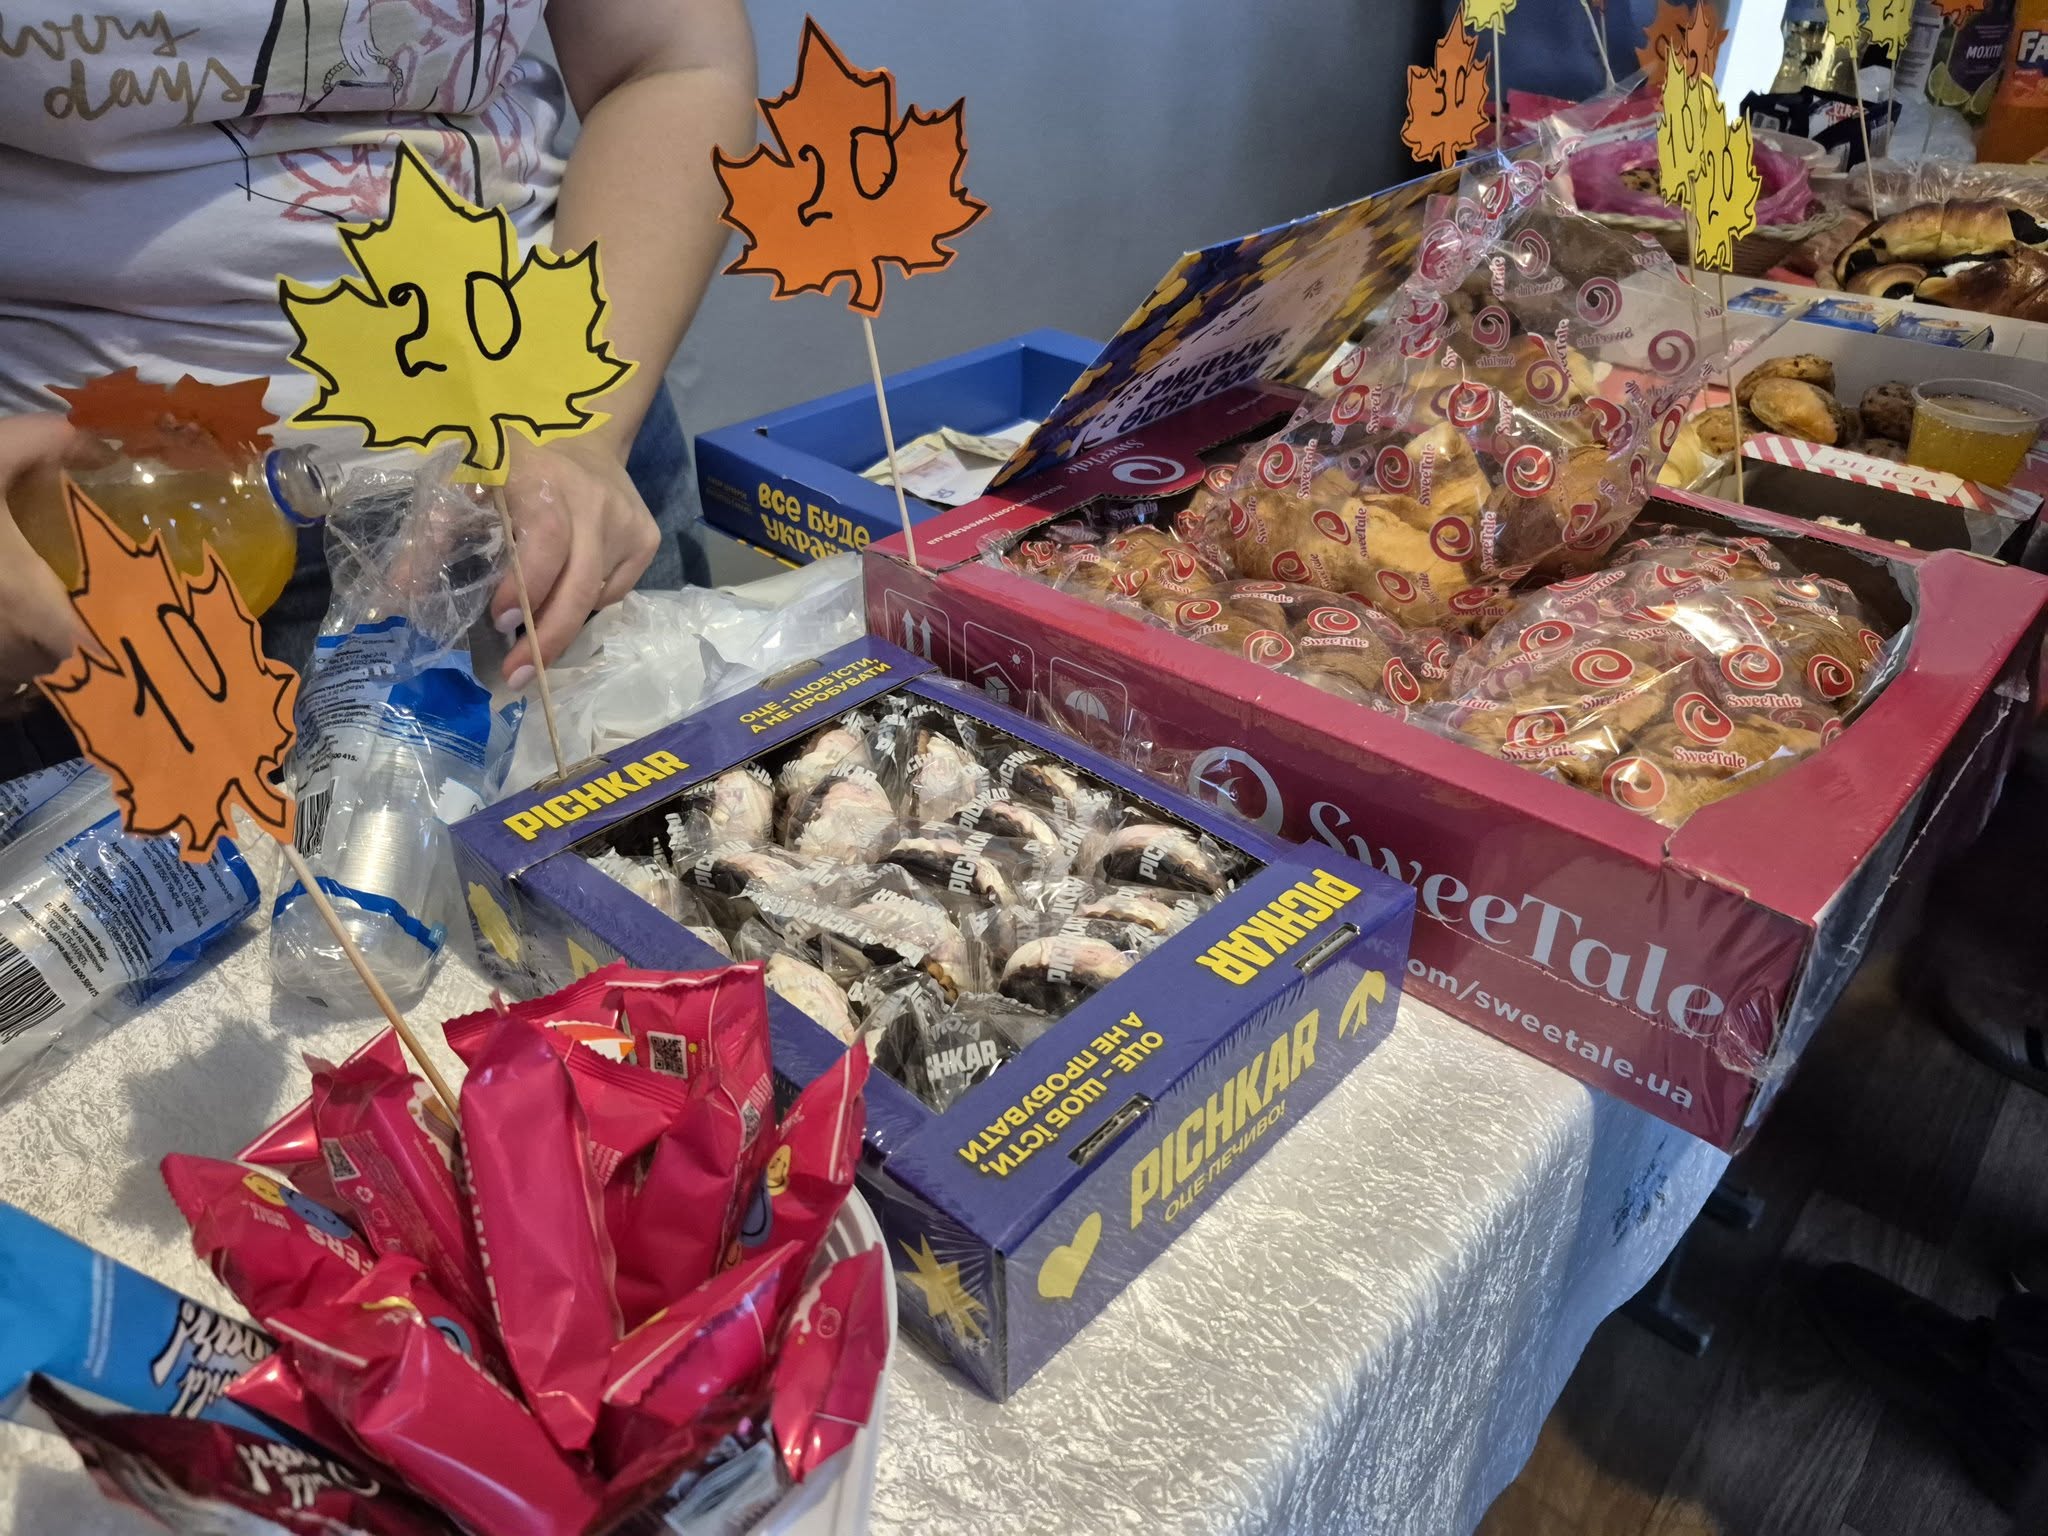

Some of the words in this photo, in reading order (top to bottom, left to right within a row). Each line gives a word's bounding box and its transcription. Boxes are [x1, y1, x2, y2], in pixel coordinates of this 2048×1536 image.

[44, 57, 262, 127] days
[1431, 65, 1466, 116] 30
[1666, 104, 1695, 169] 10
[797, 126, 897, 227] 20
[1708, 147, 1735, 225] 20
[388, 271, 521, 377] 20
[1067, 439, 1144, 475] SweeTale
[1297, 438, 1318, 499] SweeTale
[1418, 443, 1436, 506] SweeTale
[1480, 510, 1497, 573] SweeTale
[1561, 570, 1626, 608] SweeTale
[1301, 636, 1370, 649] SweeTale
[120, 603, 227, 753] 10
[751, 722, 765, 734] А
[763, 711, 793, 729] НЕ
[791, 662, 892, 715] ПРОБУВАТИ
[1725, 693, 1803, 708] SweeTale
[739, 701, 783, 725] ОЦЕ
[1672, 745, 1747, 770] SweeTale
[503, 750, 690, 842] PICHKAR
[46, 918, 60, 933] ТОВ
[1195, 869, 1362, 986] PICHKAR
[1086, 1025, 1135, 1056] НЕ
[1118, 1010, 1144, 1030] А
[1407, 957, 1695, 1110] om/sweetale.ua
[1120, 1030, 1165, 1074] ОЦЕ
[958, 1045, 1100, 1164] ПРОБУВАТИ
[1129, 1008, 1320, 1231] PICHKAR
[1163, 1172, 1208, 1223] ОЦЕ
[1205, 1099, 1287, 1184] ПЕЧИВО!
